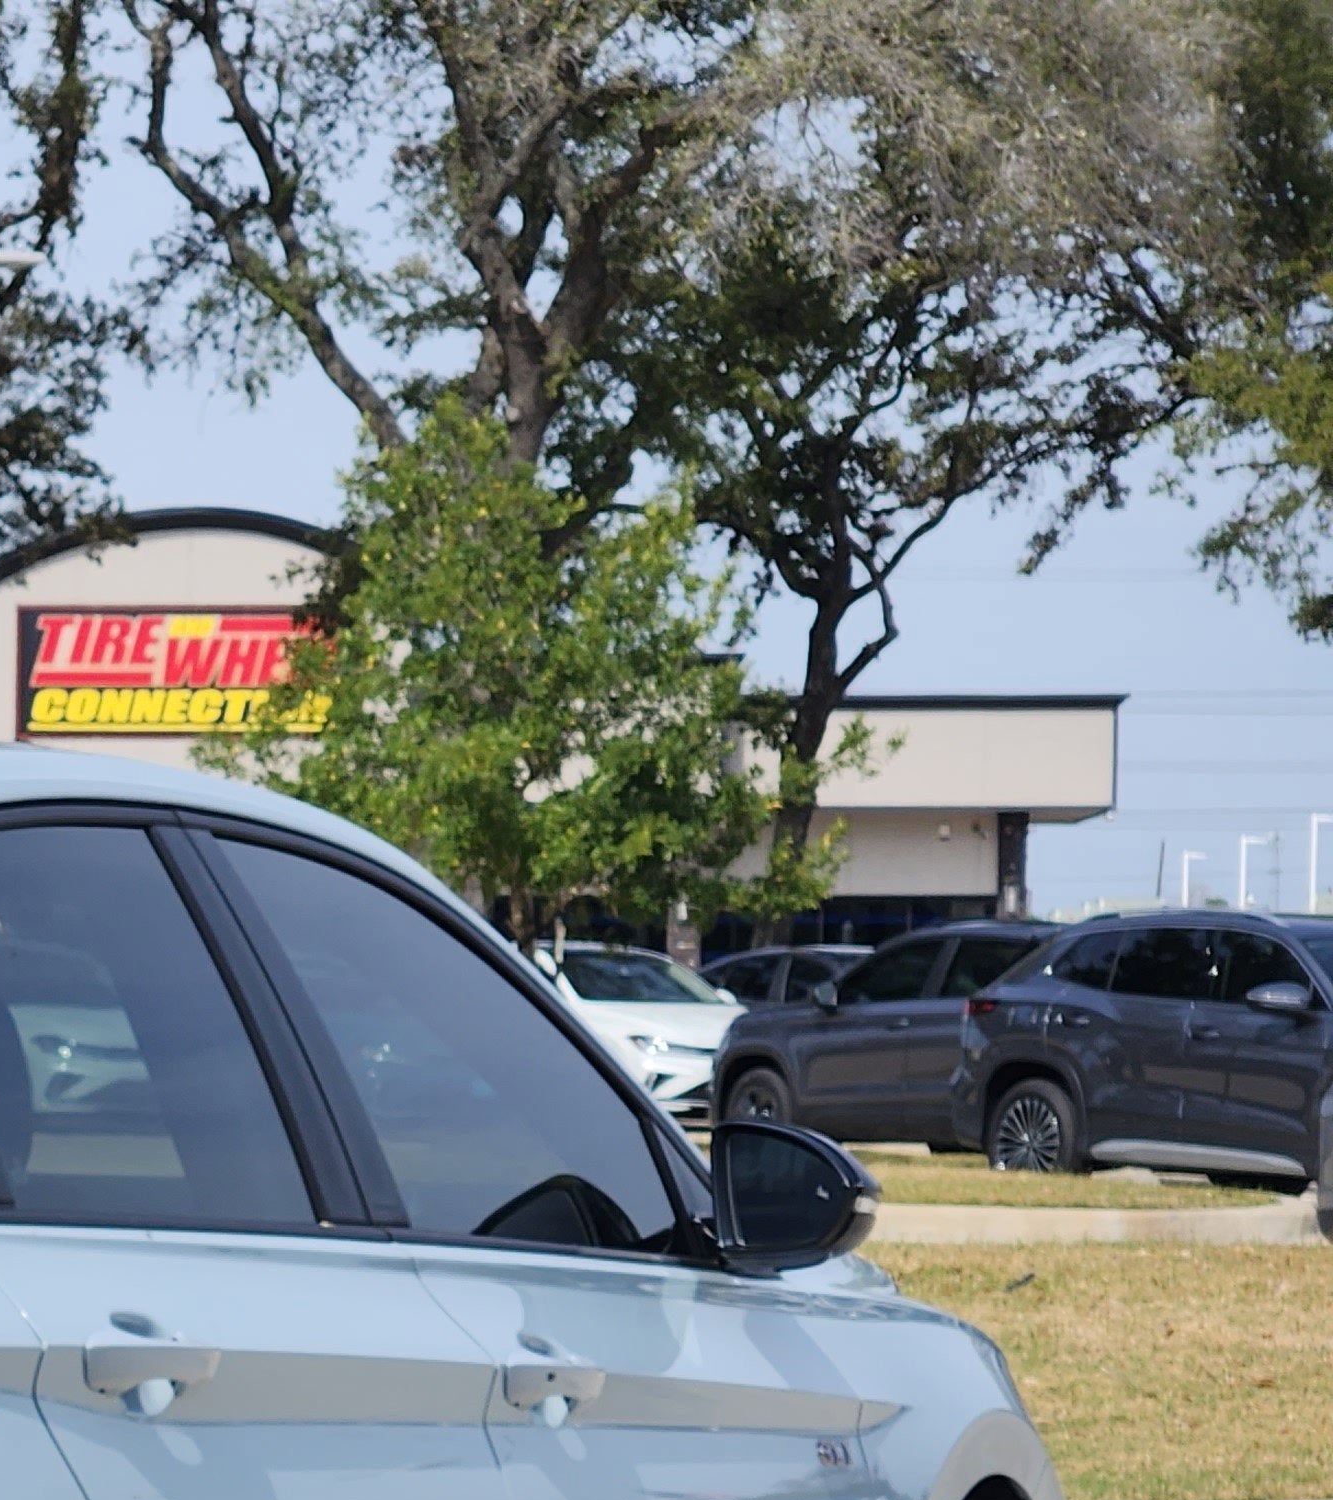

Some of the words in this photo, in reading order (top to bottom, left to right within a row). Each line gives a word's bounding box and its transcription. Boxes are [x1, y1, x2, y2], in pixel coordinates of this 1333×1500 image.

[35, 615, 164, 665] TIRE
[163, 638, 325, 686] WHE
[30, 688, 333, 723] CONNECTN
